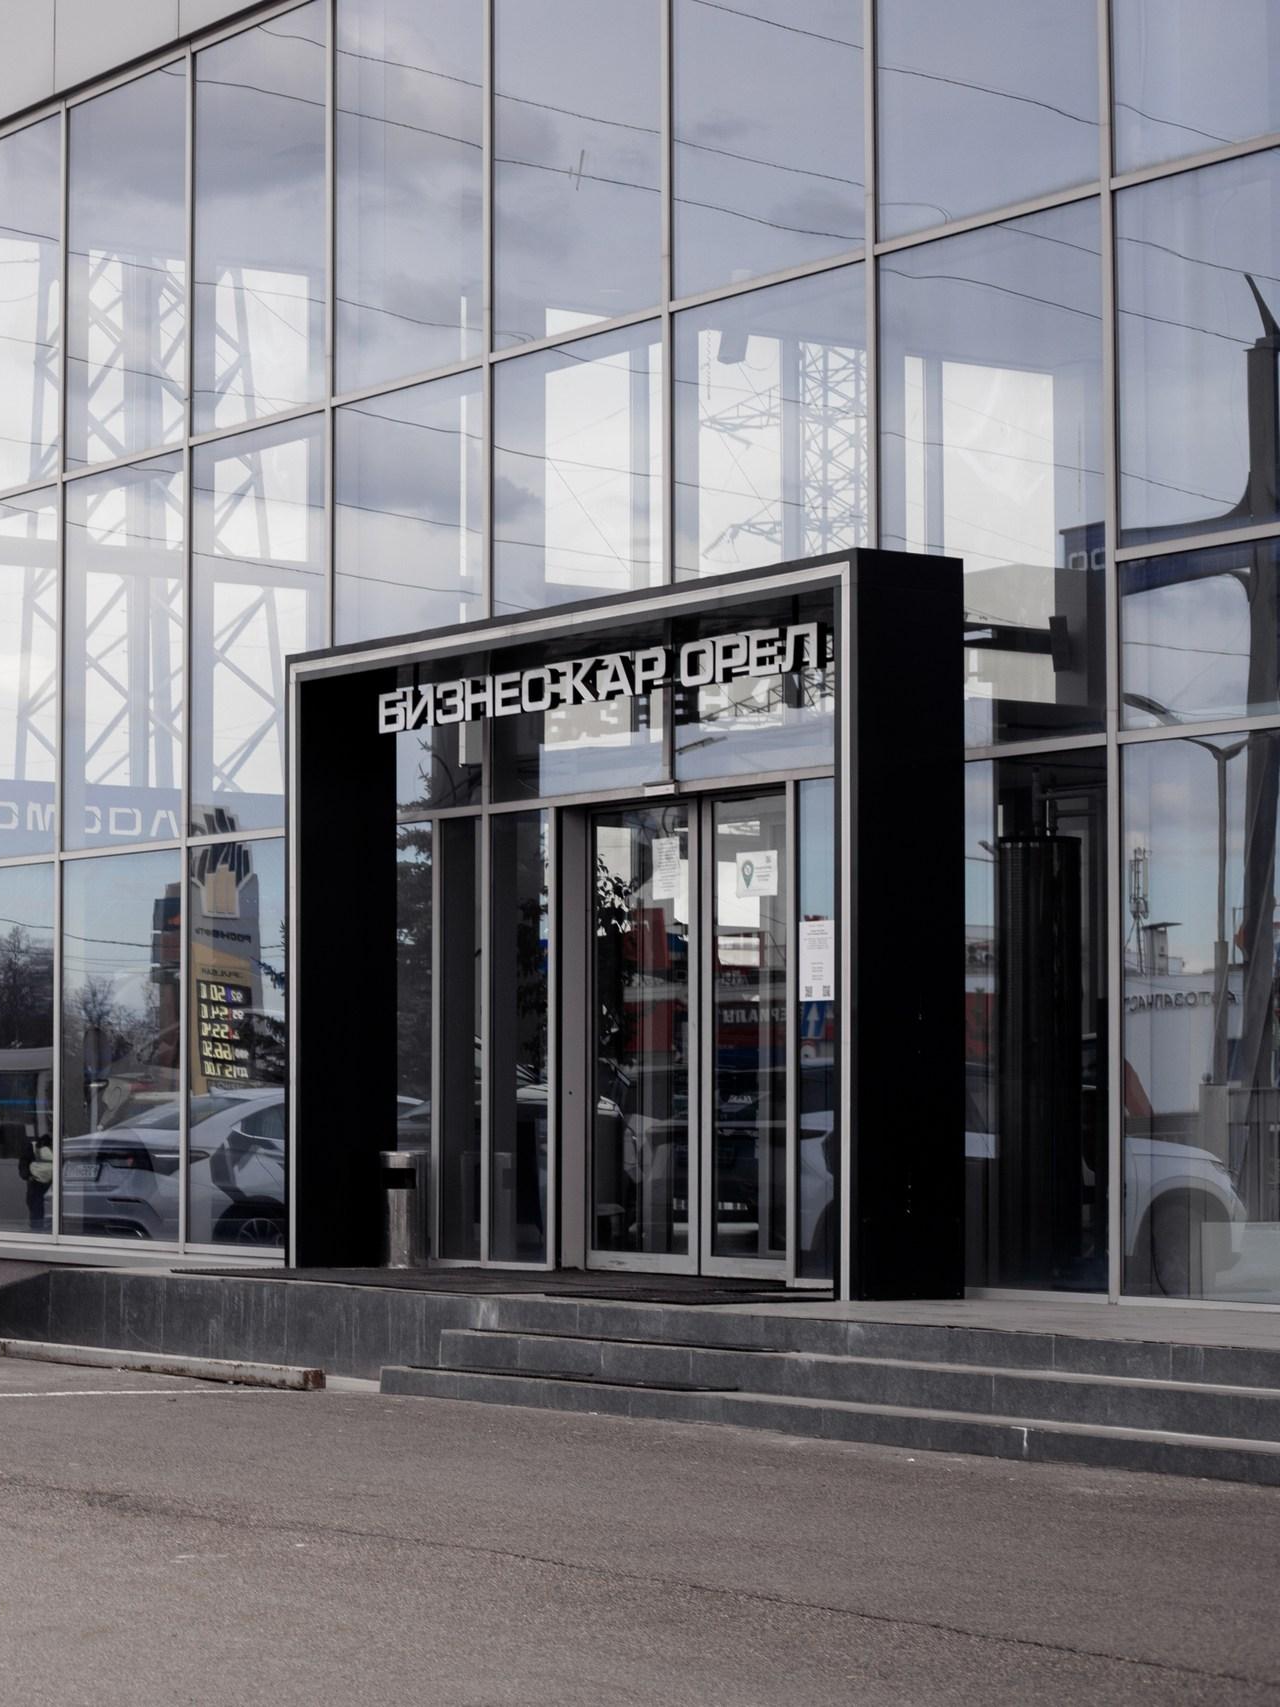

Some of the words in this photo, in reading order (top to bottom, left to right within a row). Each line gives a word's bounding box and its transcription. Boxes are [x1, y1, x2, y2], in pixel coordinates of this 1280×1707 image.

[378, 667, 551, 734] БИЗНЕС
[563, 646, 668, 704] КАР
[680, 621, 819, 687] ОРЕЛ
